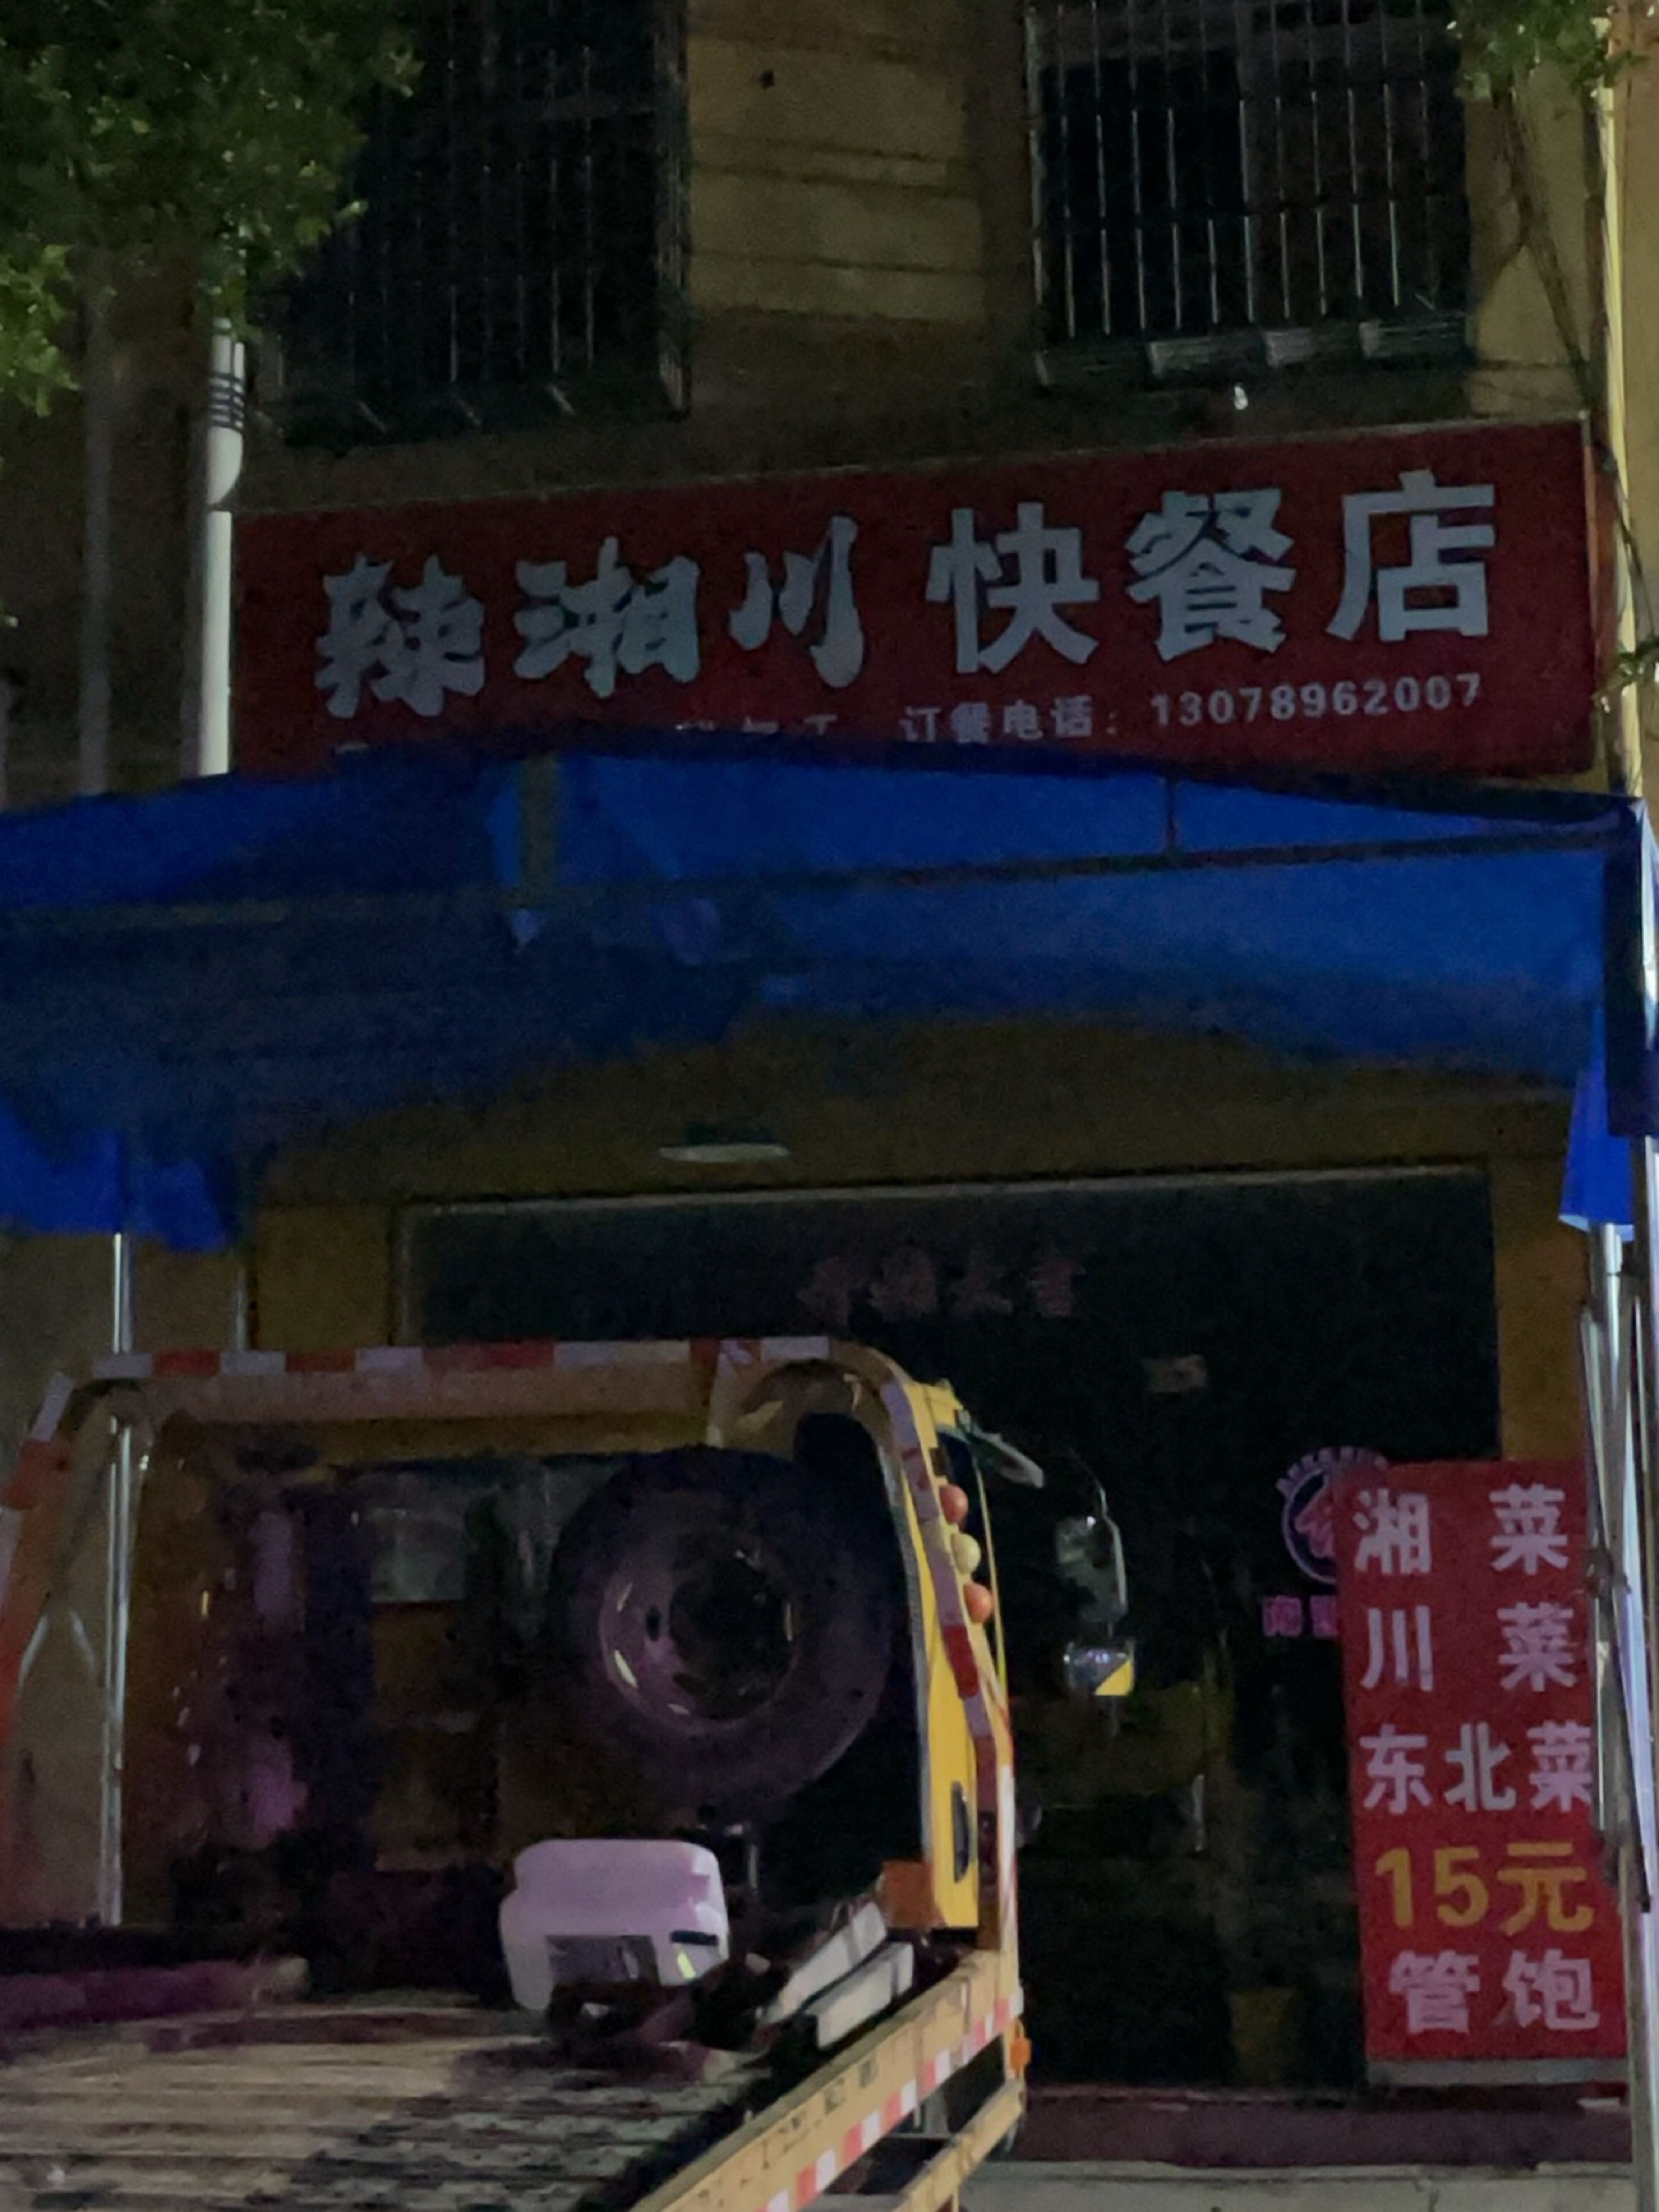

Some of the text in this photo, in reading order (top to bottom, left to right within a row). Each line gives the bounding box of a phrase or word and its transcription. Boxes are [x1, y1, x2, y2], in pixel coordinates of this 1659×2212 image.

[314, 468, 1496, 719] 辣湘川快餐店
[1153, 673, 1482, 727] 13078962007
[1353, 1484, 1569, 1575] 湘菜
[1360, 1601, 1578, 1692] 川菜
[1359, 1720, 1594, 1815] 东北菜
[1375, 1842, 1595, 1936] 15元
[1388, 1948, 1599, 2034] 管饱
